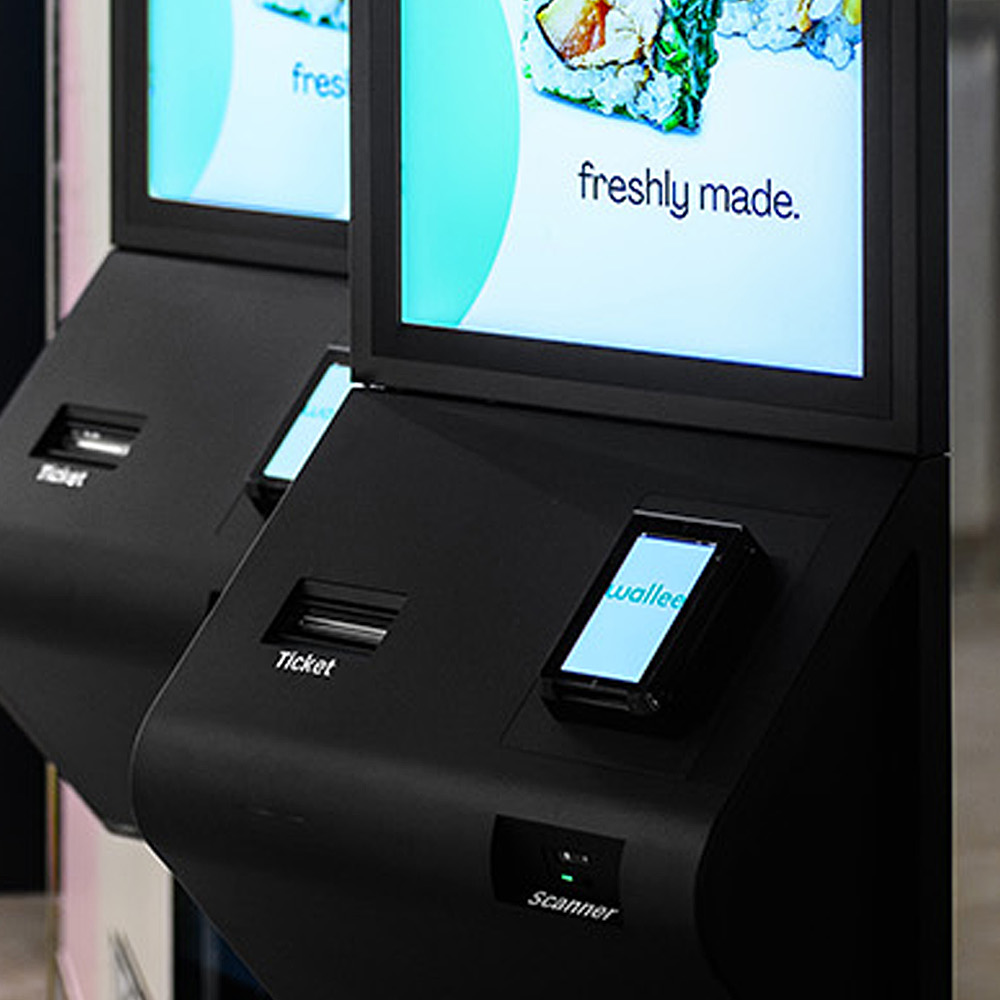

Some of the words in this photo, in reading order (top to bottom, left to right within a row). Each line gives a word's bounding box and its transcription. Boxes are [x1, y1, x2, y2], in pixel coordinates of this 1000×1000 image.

[578, 160, 688, 219] freshly
[698, 178, 800, 219] made.
[605, 582, 687, 610] wallee
[275, 650, 336, 678] Ticket
